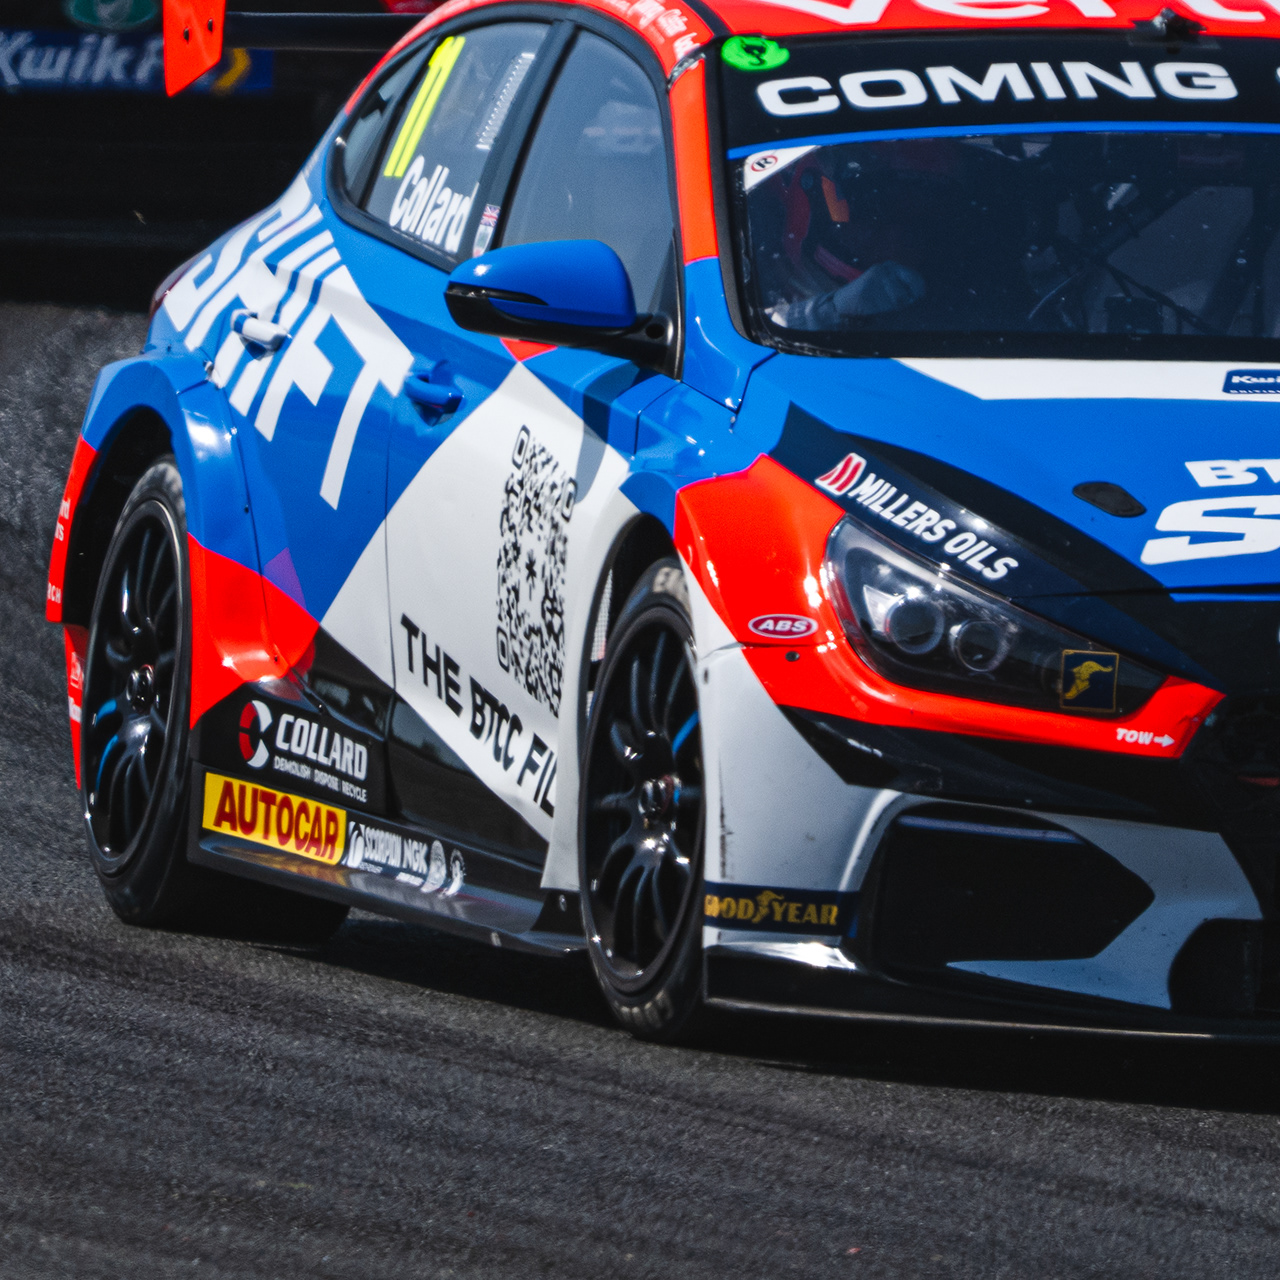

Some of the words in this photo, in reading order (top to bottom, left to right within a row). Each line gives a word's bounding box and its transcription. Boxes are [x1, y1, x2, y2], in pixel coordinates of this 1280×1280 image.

[383, 36, 467, 177] 11
[757, 60, 1239, 117] COMING
[389, 154, 480, 254] Collard
[164, 173, 414, 510] SHIFT
[847, 472, 957, 543] MILLERS
[943, 531, 1020, 580] OILS
[757, 619, 809, 633] ABS
[401, 613, 463, 718] THE
[469, 674, 523, 772] BTCC
[274, 712, 369, 781] COLLARD
[1116, 727, 1154, 746] TOW
[213, 780, 341, 862] AUTOCAR
[402, 838, 428, 875] NGK
[704, 891, 838, 925] OODYEAR
